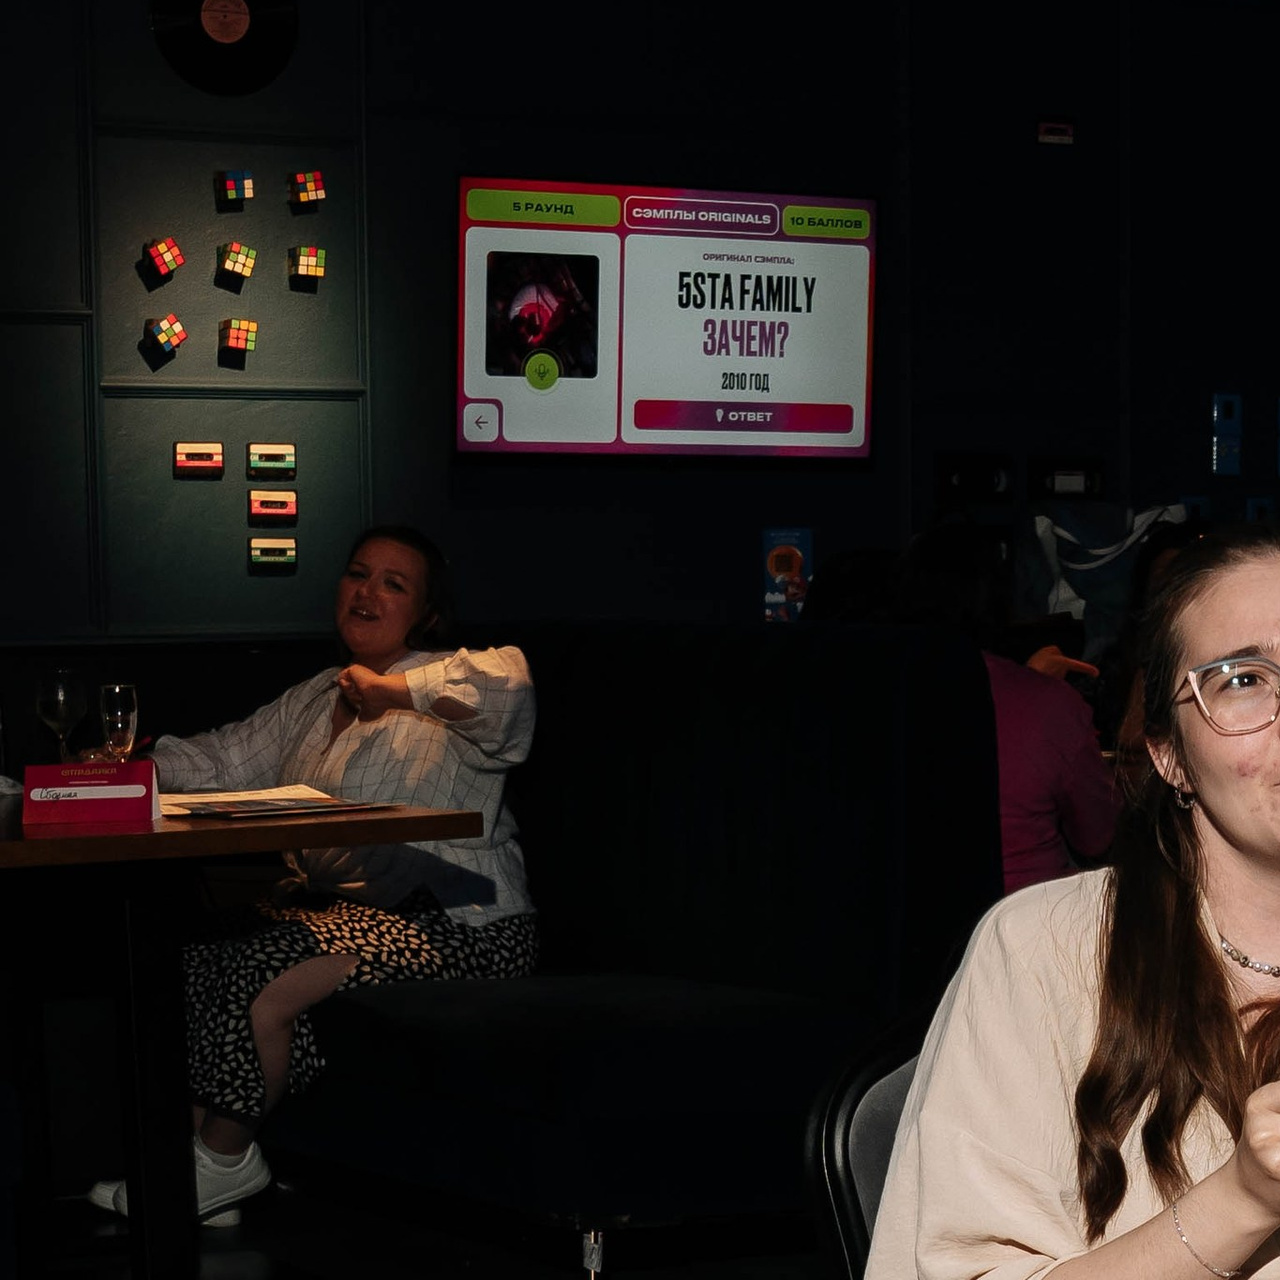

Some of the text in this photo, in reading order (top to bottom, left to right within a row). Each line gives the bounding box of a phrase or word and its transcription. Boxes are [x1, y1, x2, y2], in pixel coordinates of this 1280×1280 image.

[512, 202, 575, 215] 5 РАУНД
[632, 207, 771, 225] СЭМПЛЫ ORIGINALS
[790, 216, 863, 229] 10 БАЛЛОВ
[702, 253, 795, 265] ОРИГИНАЛ СЭМПЛА:
[678, 271, 816, 313] 5STA FAMILY
[703, 319, 789, 358] ЗАЧЕМ?
[721, 372, 770, 393] 2010 ГОД
[728, 411, 773, 422] ОТВЕТ
